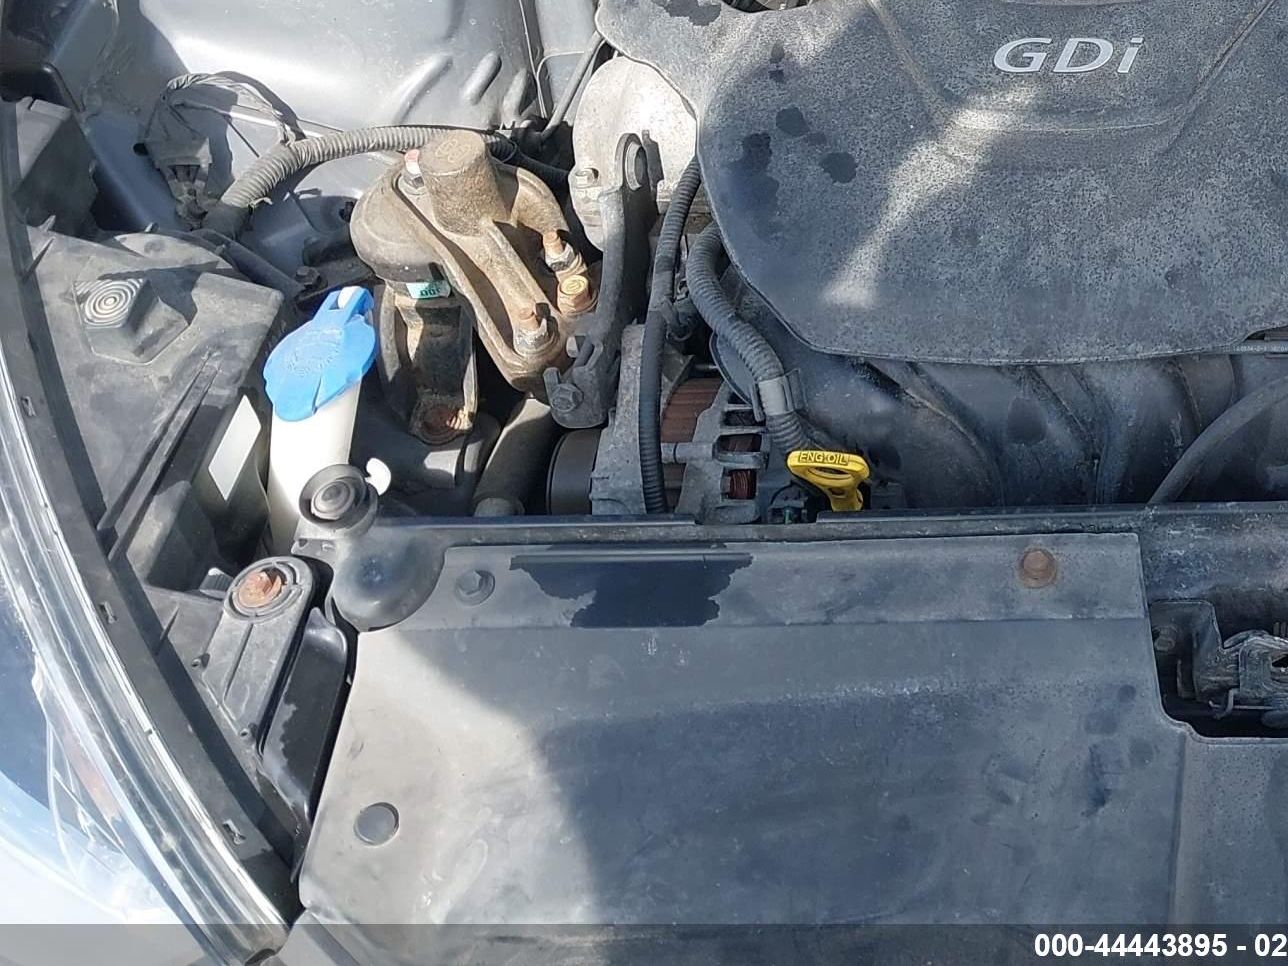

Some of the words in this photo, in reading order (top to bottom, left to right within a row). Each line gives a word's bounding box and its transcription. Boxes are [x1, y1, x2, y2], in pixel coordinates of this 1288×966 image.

[993, 37, 1144, 73] GDi
[799, 451, 823, 464] ENG
[827, 453, 849, 466] OIL
